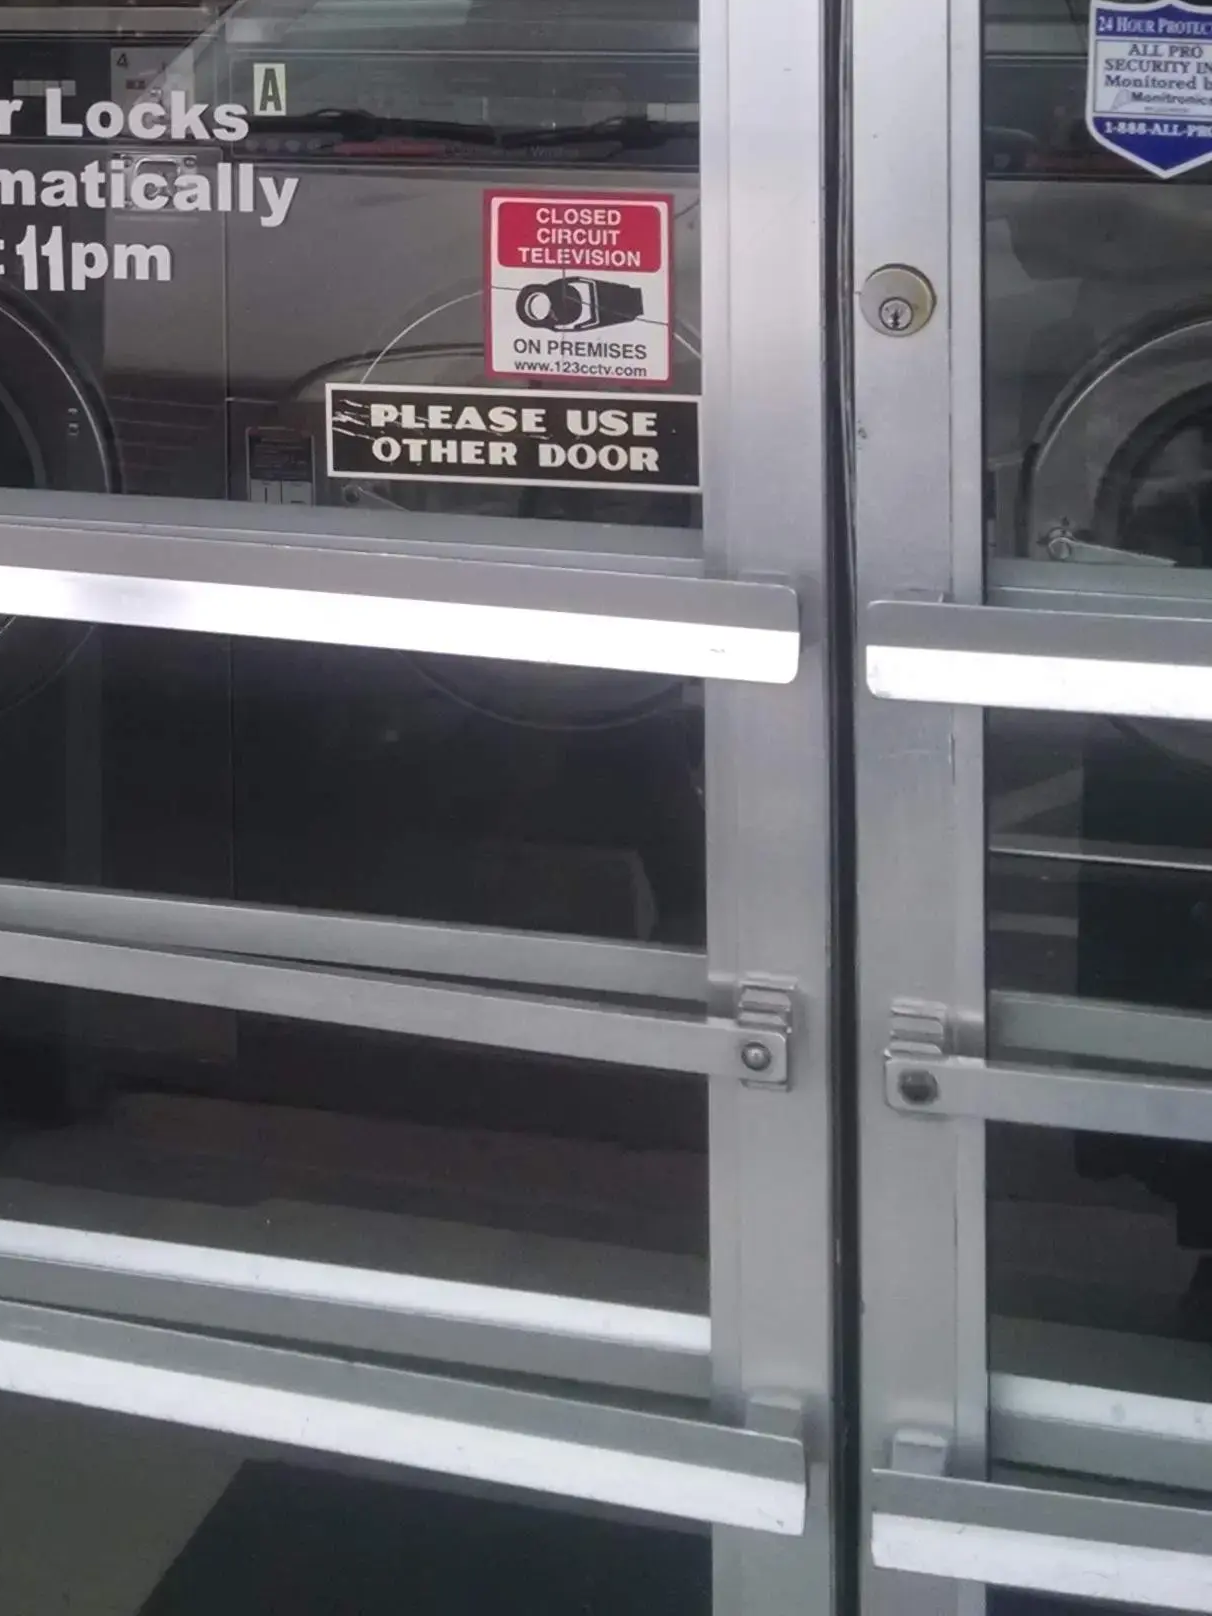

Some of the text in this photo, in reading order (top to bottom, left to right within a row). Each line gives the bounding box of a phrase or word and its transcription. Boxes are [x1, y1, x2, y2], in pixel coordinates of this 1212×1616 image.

[1128, 44, 1204, 59] ALL PRO
[1104, 59, 1191, 74] SECURITY
[259, 67, 283, 112] A
[1105, 74, 1197, 90] Monitored
[45, 88, 251, 142] Locks
[535, 207, 622, 226] CLOSED
[536, 227, 621, 246] CIRCUIT
[16, 225, 173, 292] 11pm
[517, 247, 641, 267] TELEVISION
[513, 338, 648, 360] ON PREMISES
[514, 360, 647, 377] www.123cctv.com
[370, 403, 658, 437] PLEASE USE
[371, 436, 660, 472] OTHER DOOR
